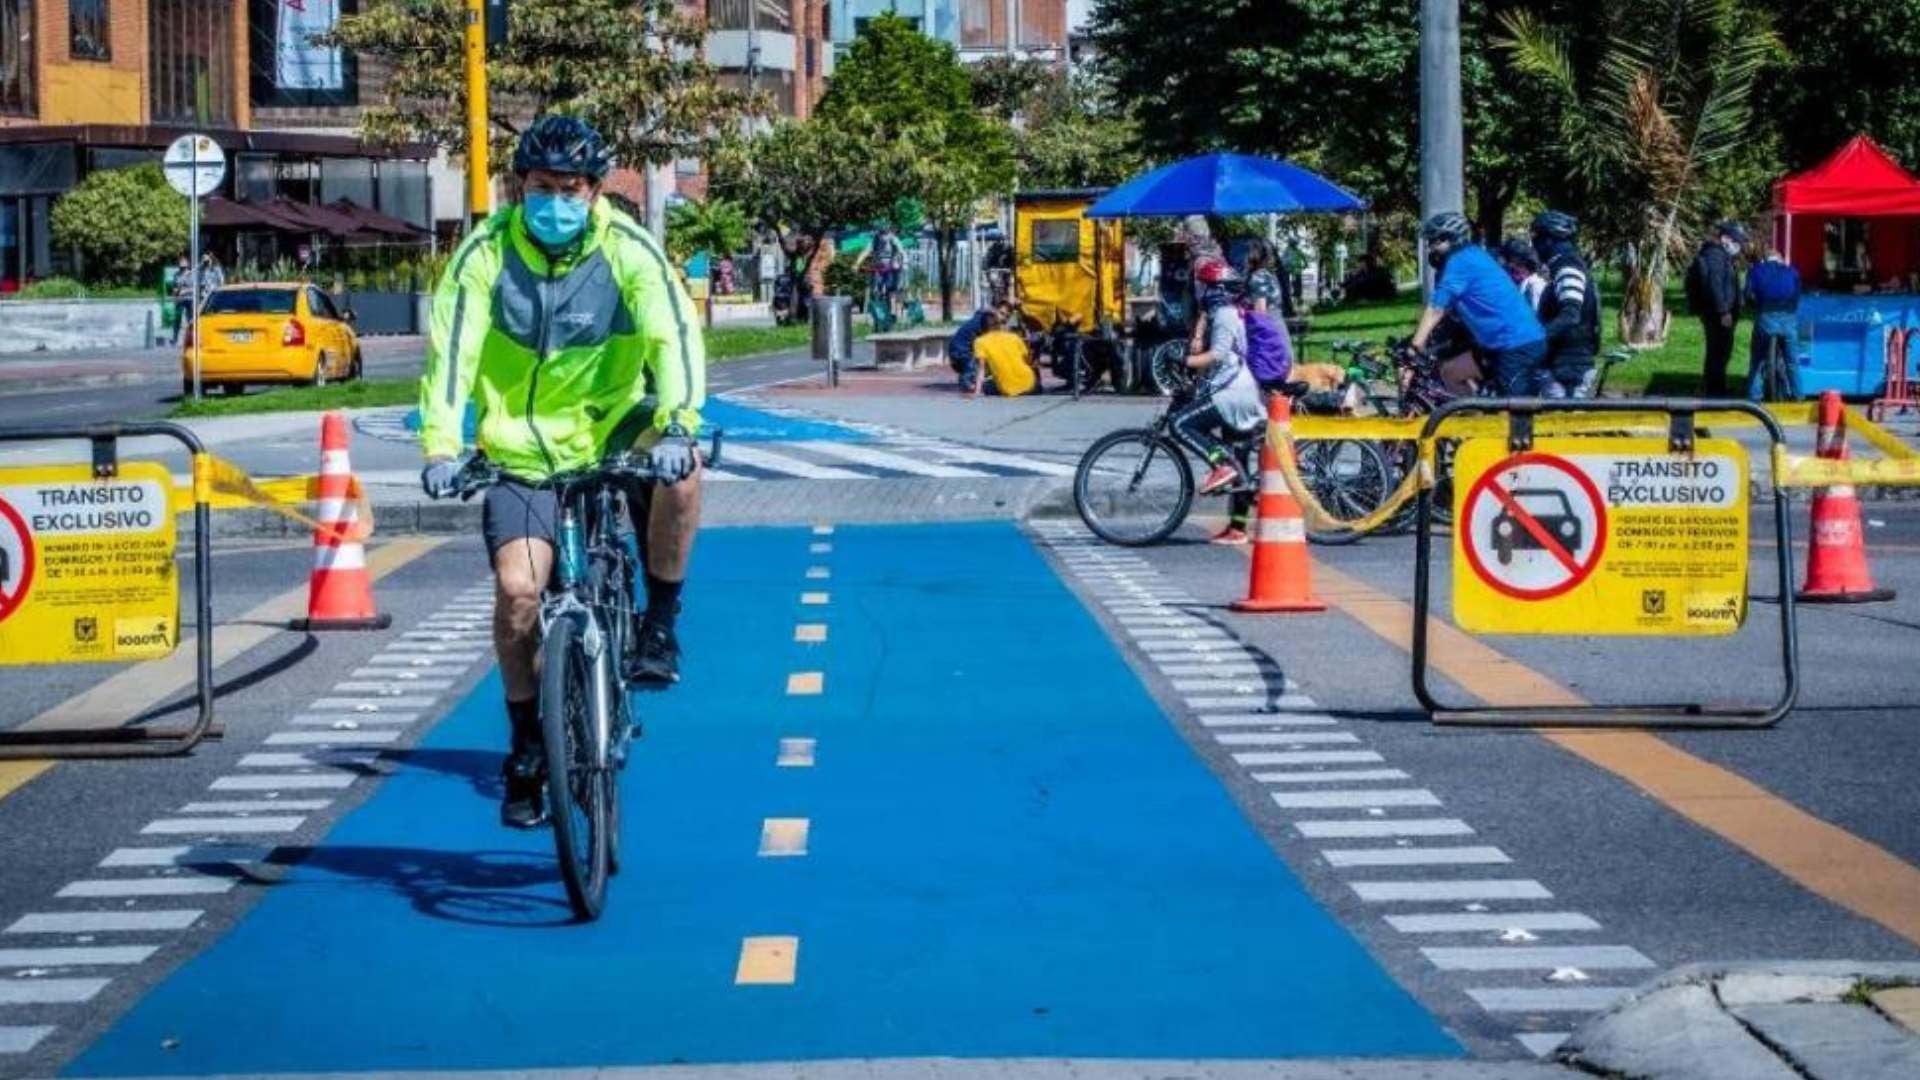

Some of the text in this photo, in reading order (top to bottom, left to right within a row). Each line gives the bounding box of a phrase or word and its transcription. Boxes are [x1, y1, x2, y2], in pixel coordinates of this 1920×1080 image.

[1614, 457, 1719, 478] TRÁNSITO
[38, 485, 144, 507] TRÁNSITO
[1608, 486, 1726, 503] EXCLUSIVO
[32, 510, 152, 531] EXCLUSIVO
